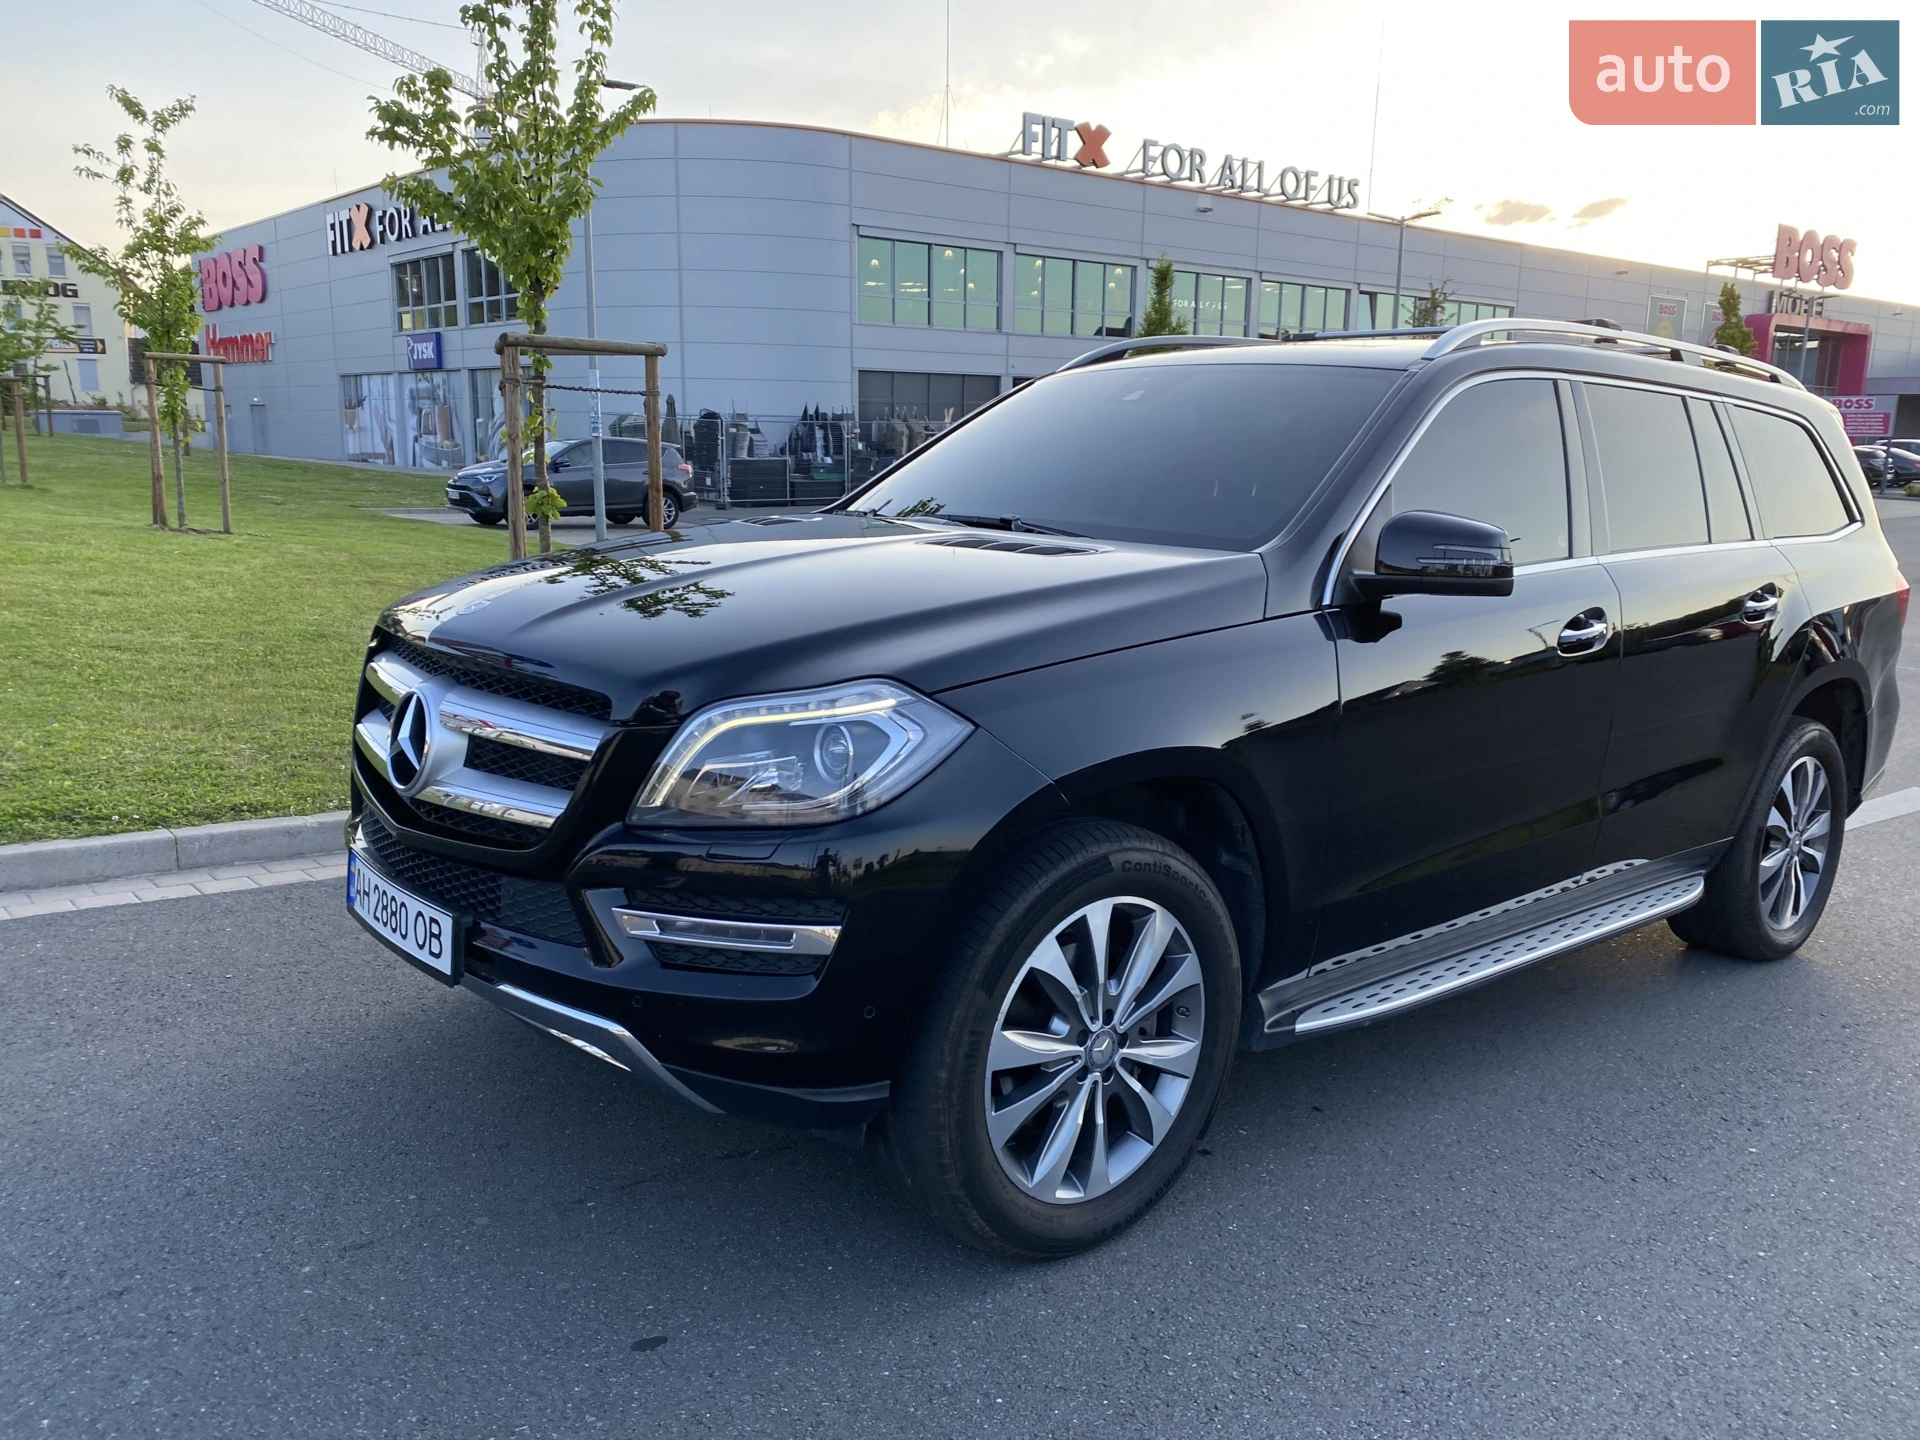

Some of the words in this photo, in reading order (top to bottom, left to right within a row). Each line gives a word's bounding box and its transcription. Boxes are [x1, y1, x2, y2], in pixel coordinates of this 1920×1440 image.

[1142, 138, 1206, 183] FOR
[1218, 154, 1270, 194] ALL
[1280, 166, 1319, 201] OF
[1327, 174, 1360, 209] US
[375, 203, 415, 244] FOR
[1772, 223, 1857, 290] BOSS
[200, 244, 266, 311] BOSS
[1658, 304, 1677, 316] BOSS
[205, 324, 275, 364] Hammer
[413, 341, 435, 360] JYSK
[1832, 399, 1875, 410] BOSS
[356, 867, 371, 916] AH
[373, 883, 409, 940] 2880
[414, 910, 443, 959] OB
